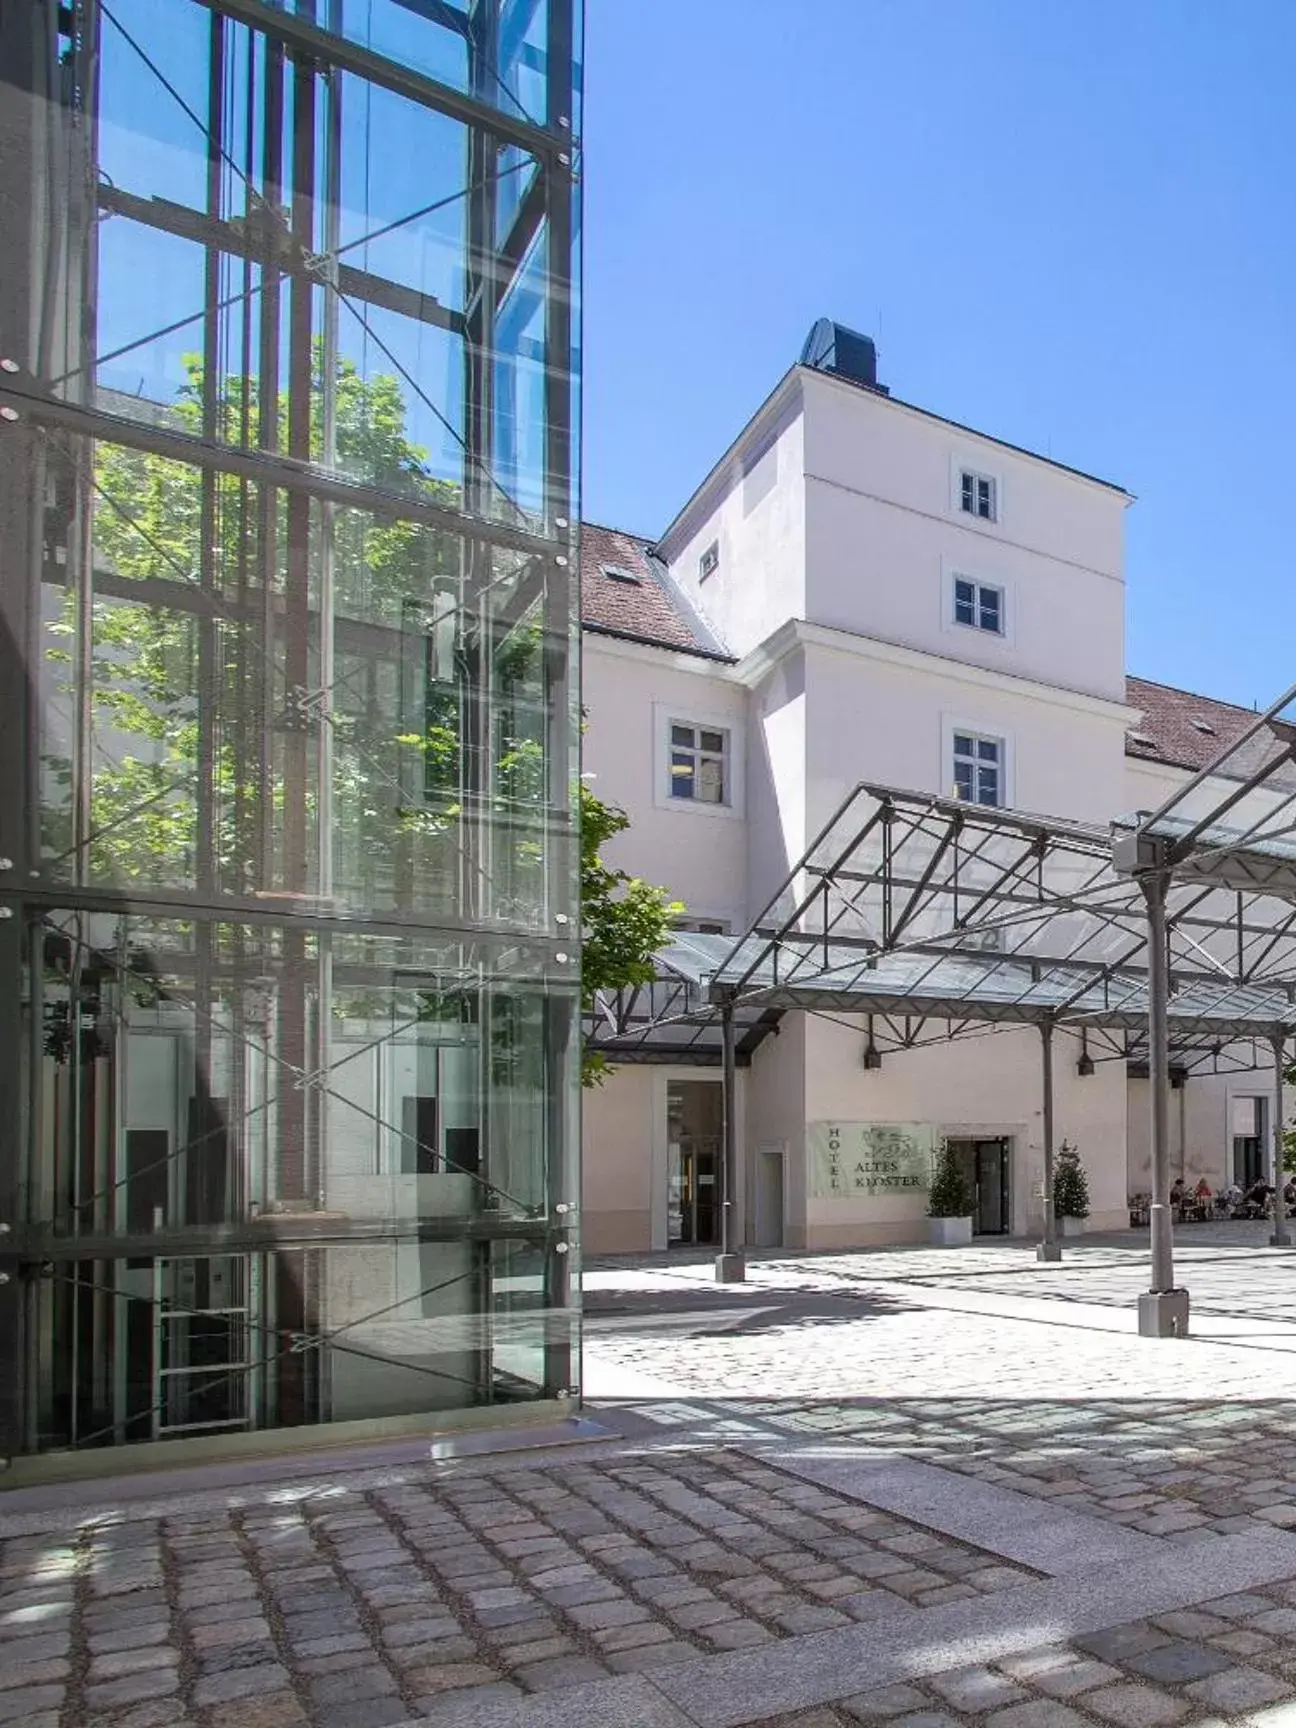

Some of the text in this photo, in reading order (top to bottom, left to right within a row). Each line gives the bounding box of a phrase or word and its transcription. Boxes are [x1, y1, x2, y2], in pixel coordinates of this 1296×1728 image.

[828, 1128, 840, 1189] HOTEL
[854, 1162, 898, 1173] ALTES
[855, 1176, 921, 1187] KLOSTER
